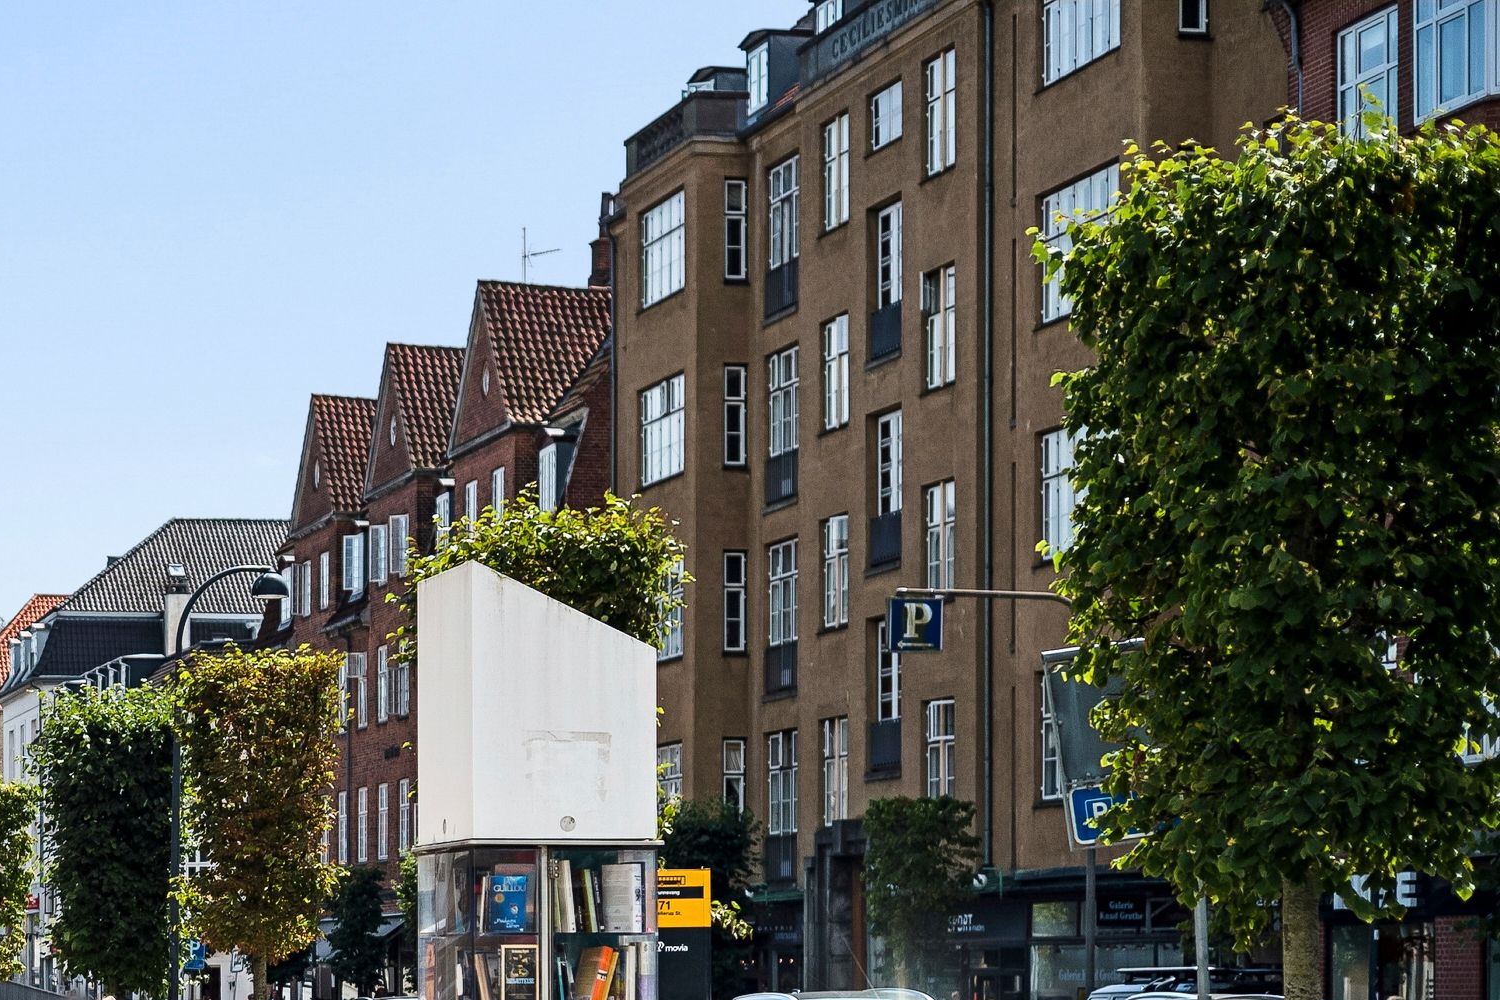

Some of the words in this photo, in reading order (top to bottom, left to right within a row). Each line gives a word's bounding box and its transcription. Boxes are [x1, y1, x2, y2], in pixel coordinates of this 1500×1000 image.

[903, 602, 933, 638] P
[1092, 801, 1108, 819] P
[665, 943, 689, 953] movia
